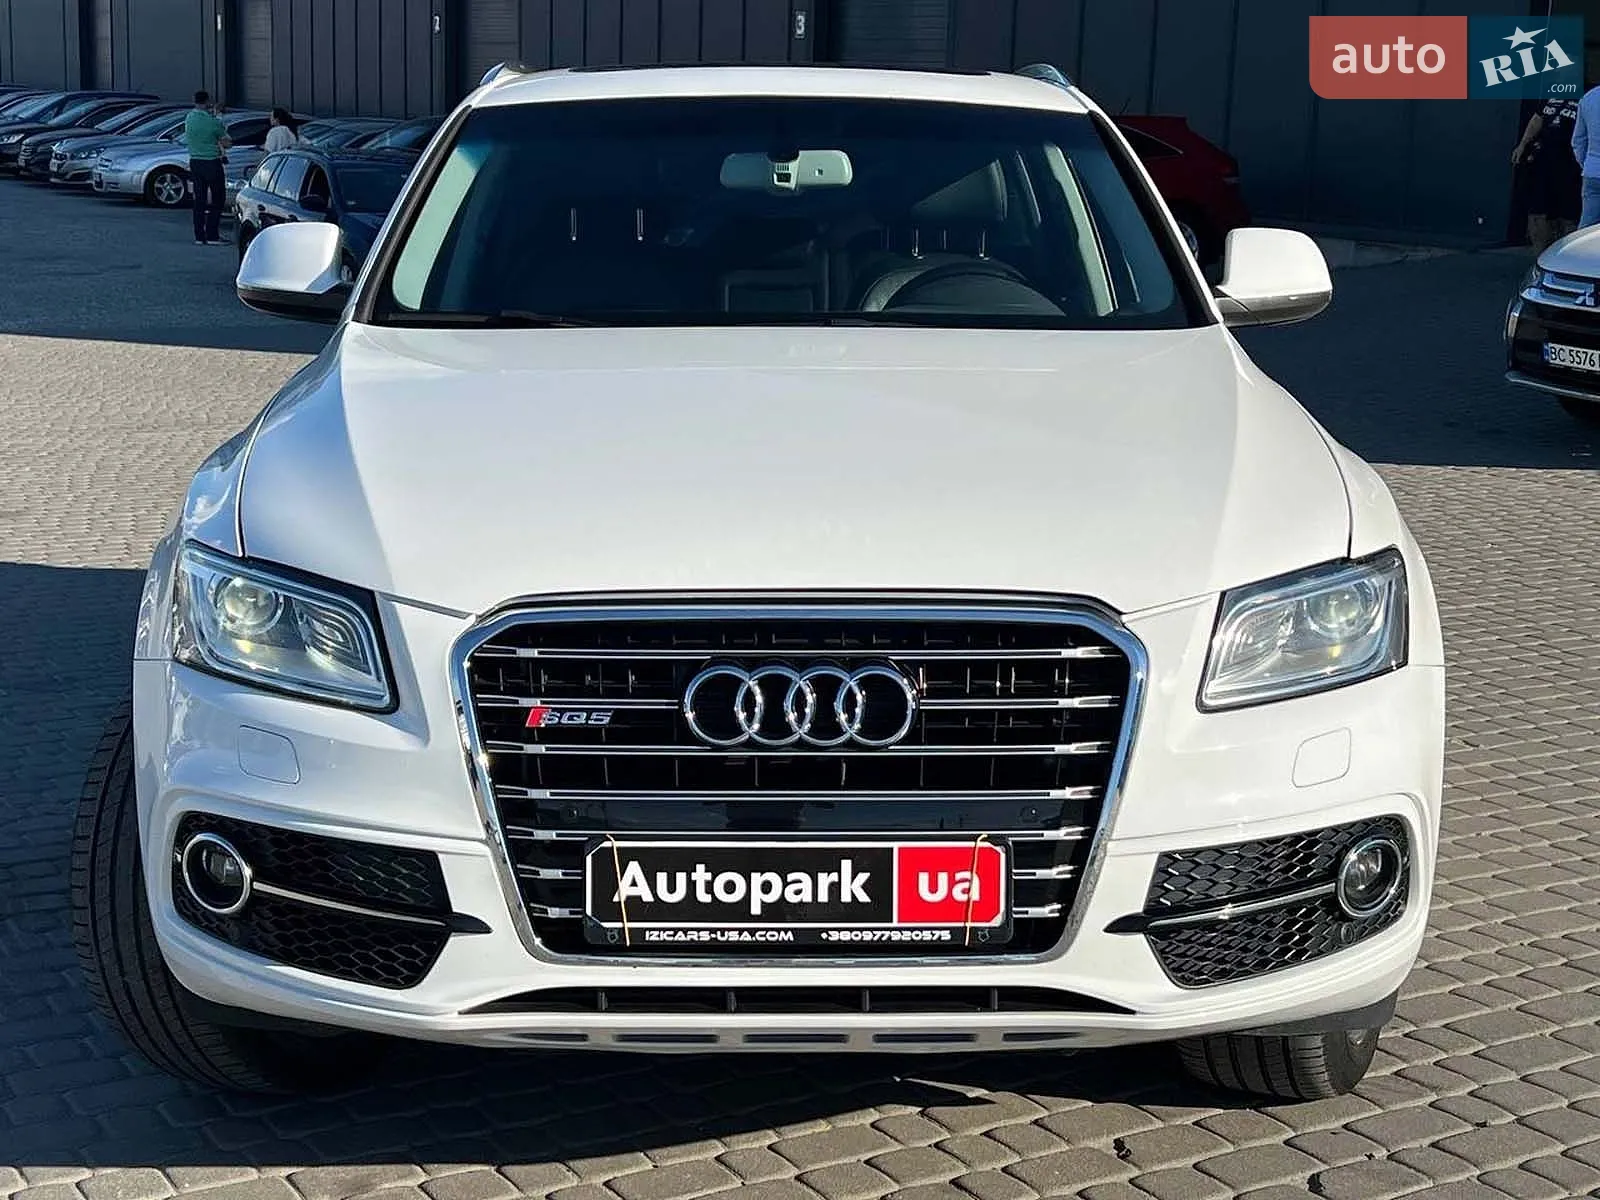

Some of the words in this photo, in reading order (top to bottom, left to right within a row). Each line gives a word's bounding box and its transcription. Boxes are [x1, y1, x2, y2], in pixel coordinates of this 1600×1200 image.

[796, 15, 805, 35] 3
[1550, 346, 1566, 362] BC
[1568, 349, 1596, 367] 5576
[613, 859, 872, 915] Autopark
[918, 873, 981, 903] ua
[645, 930, 794, 942] IZICARS-USA.COM
